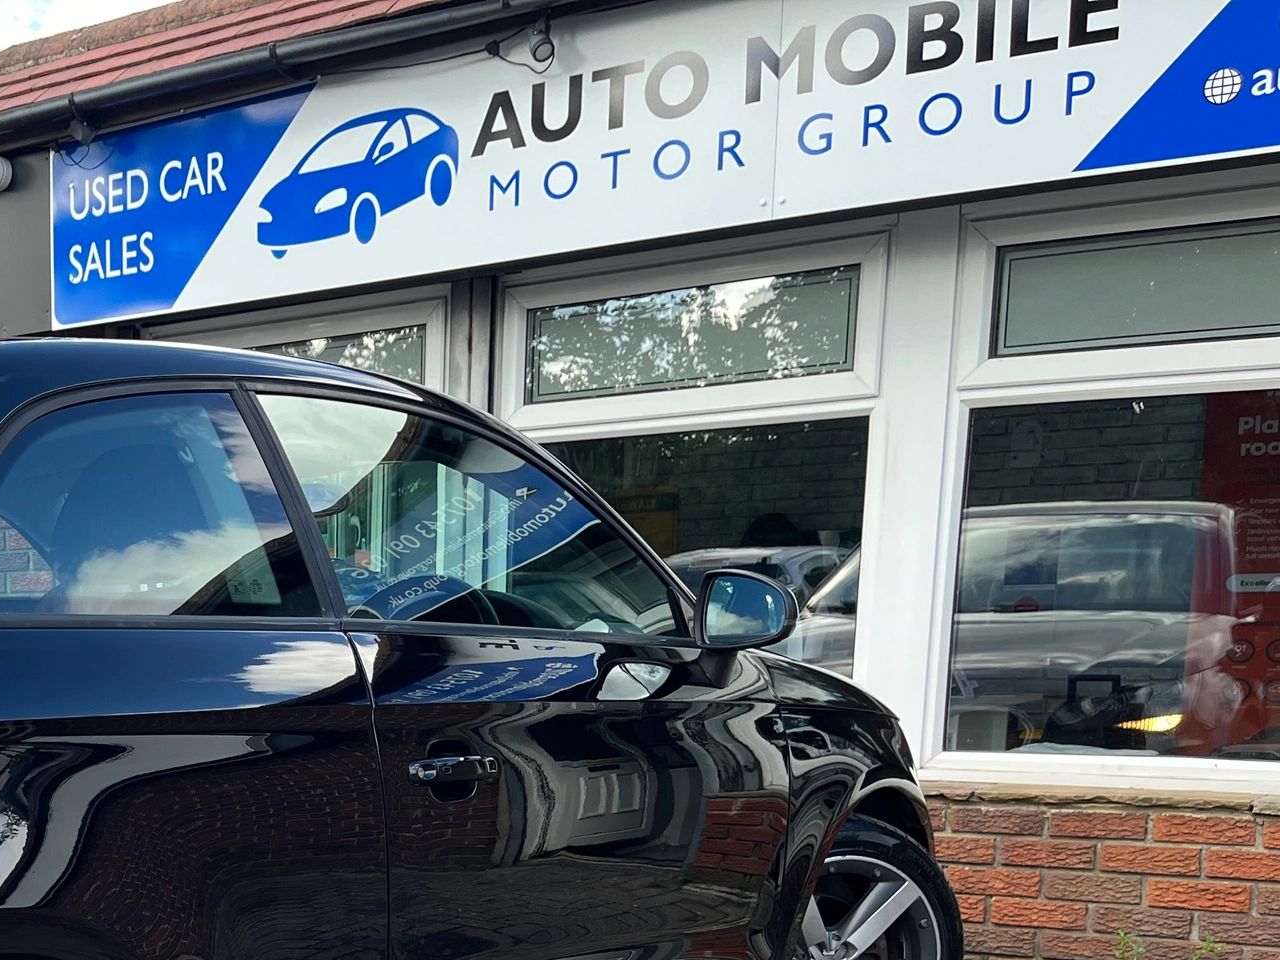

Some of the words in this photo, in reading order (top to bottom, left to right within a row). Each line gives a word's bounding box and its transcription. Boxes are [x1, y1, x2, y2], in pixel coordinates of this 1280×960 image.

[471, 50, 709, 158] AUTO
[745, 0, 1120, 105] MOBILE
[1251, 67, 1280, 97] a
[489, 129, 746, 212] MOTOR
[798, 70, 1096, 156] GROUP
[67, 168, 149, 222] USED
[159, 151, 228, 204] CAR
[67, 231, 156, 285] SALES
